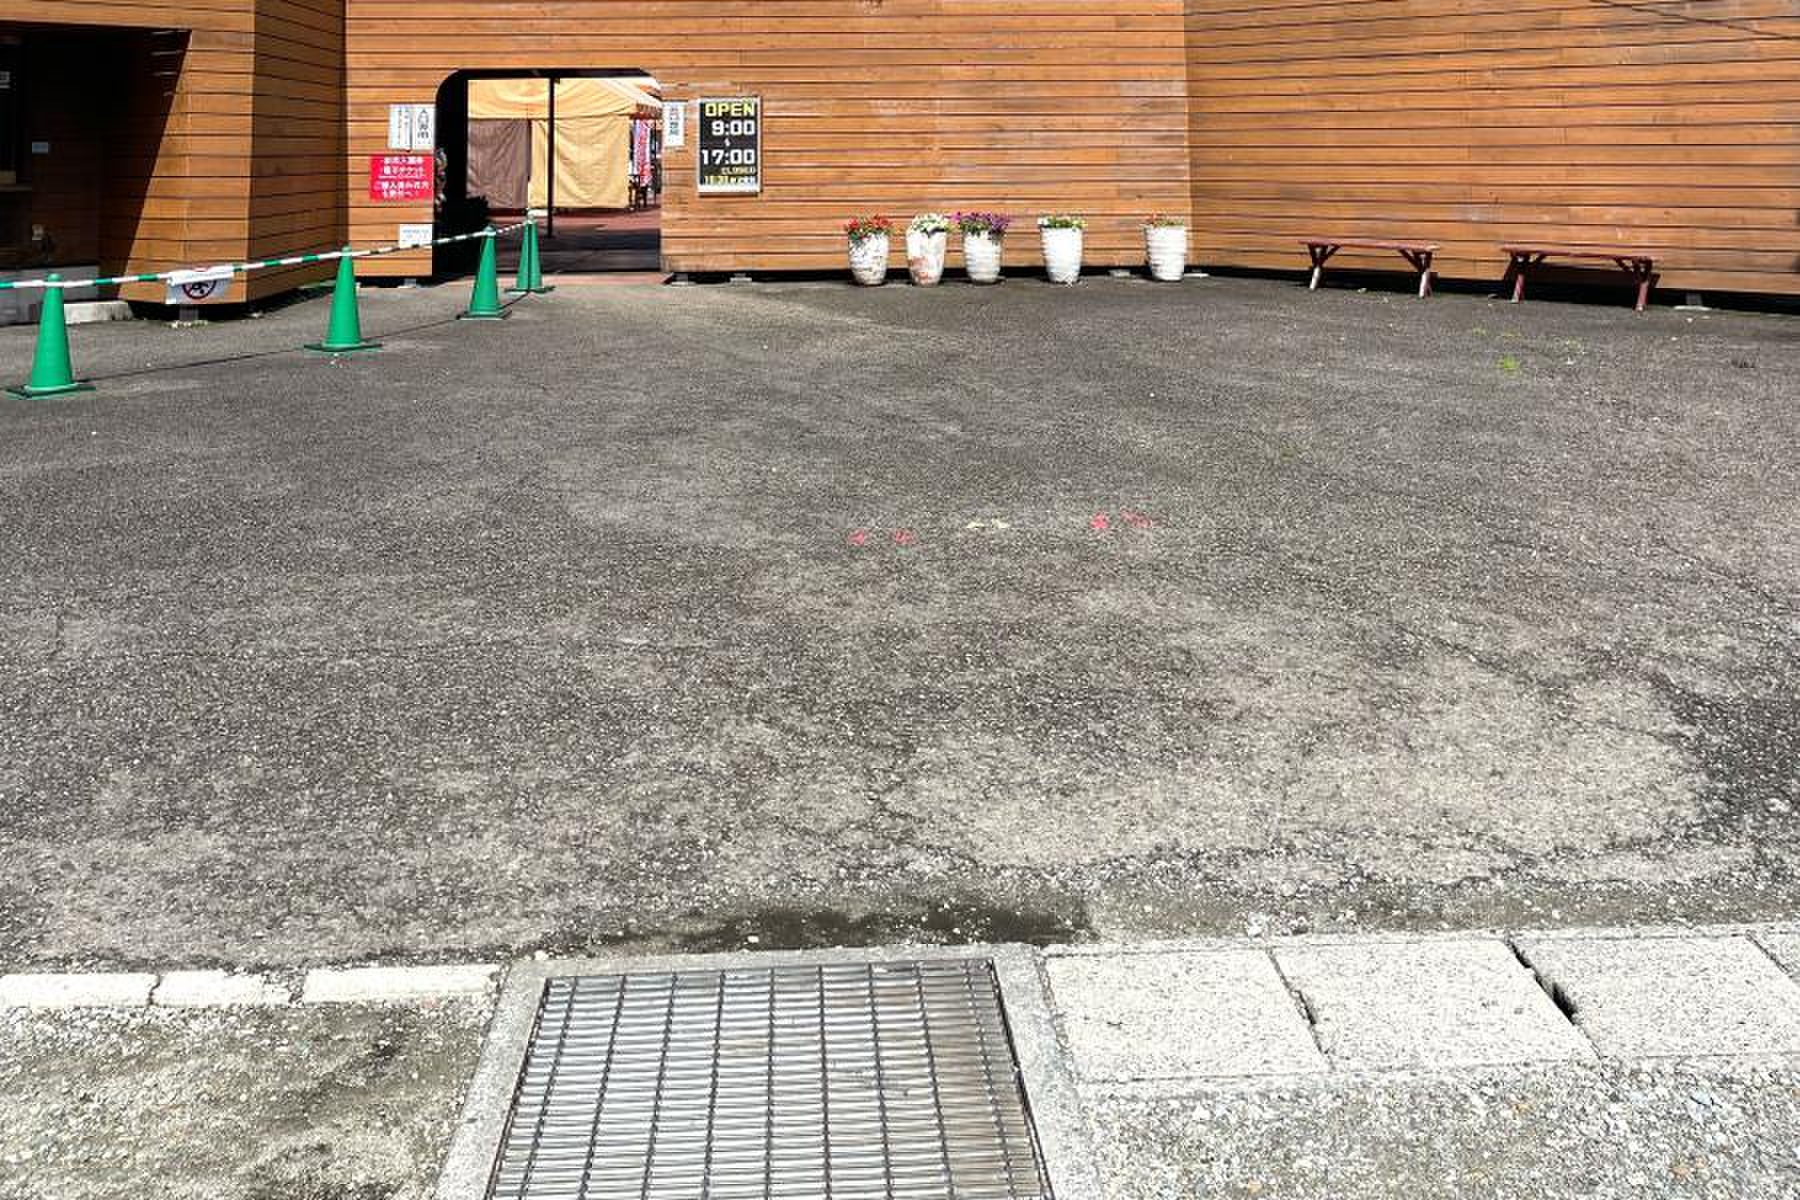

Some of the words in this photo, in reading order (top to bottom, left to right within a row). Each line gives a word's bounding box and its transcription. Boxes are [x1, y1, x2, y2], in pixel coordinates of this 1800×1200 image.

[704, 102, 755, 117] OPEN
[711, 119, 755, 136] 9:00
[701, 148, 755, 165] 17:00
